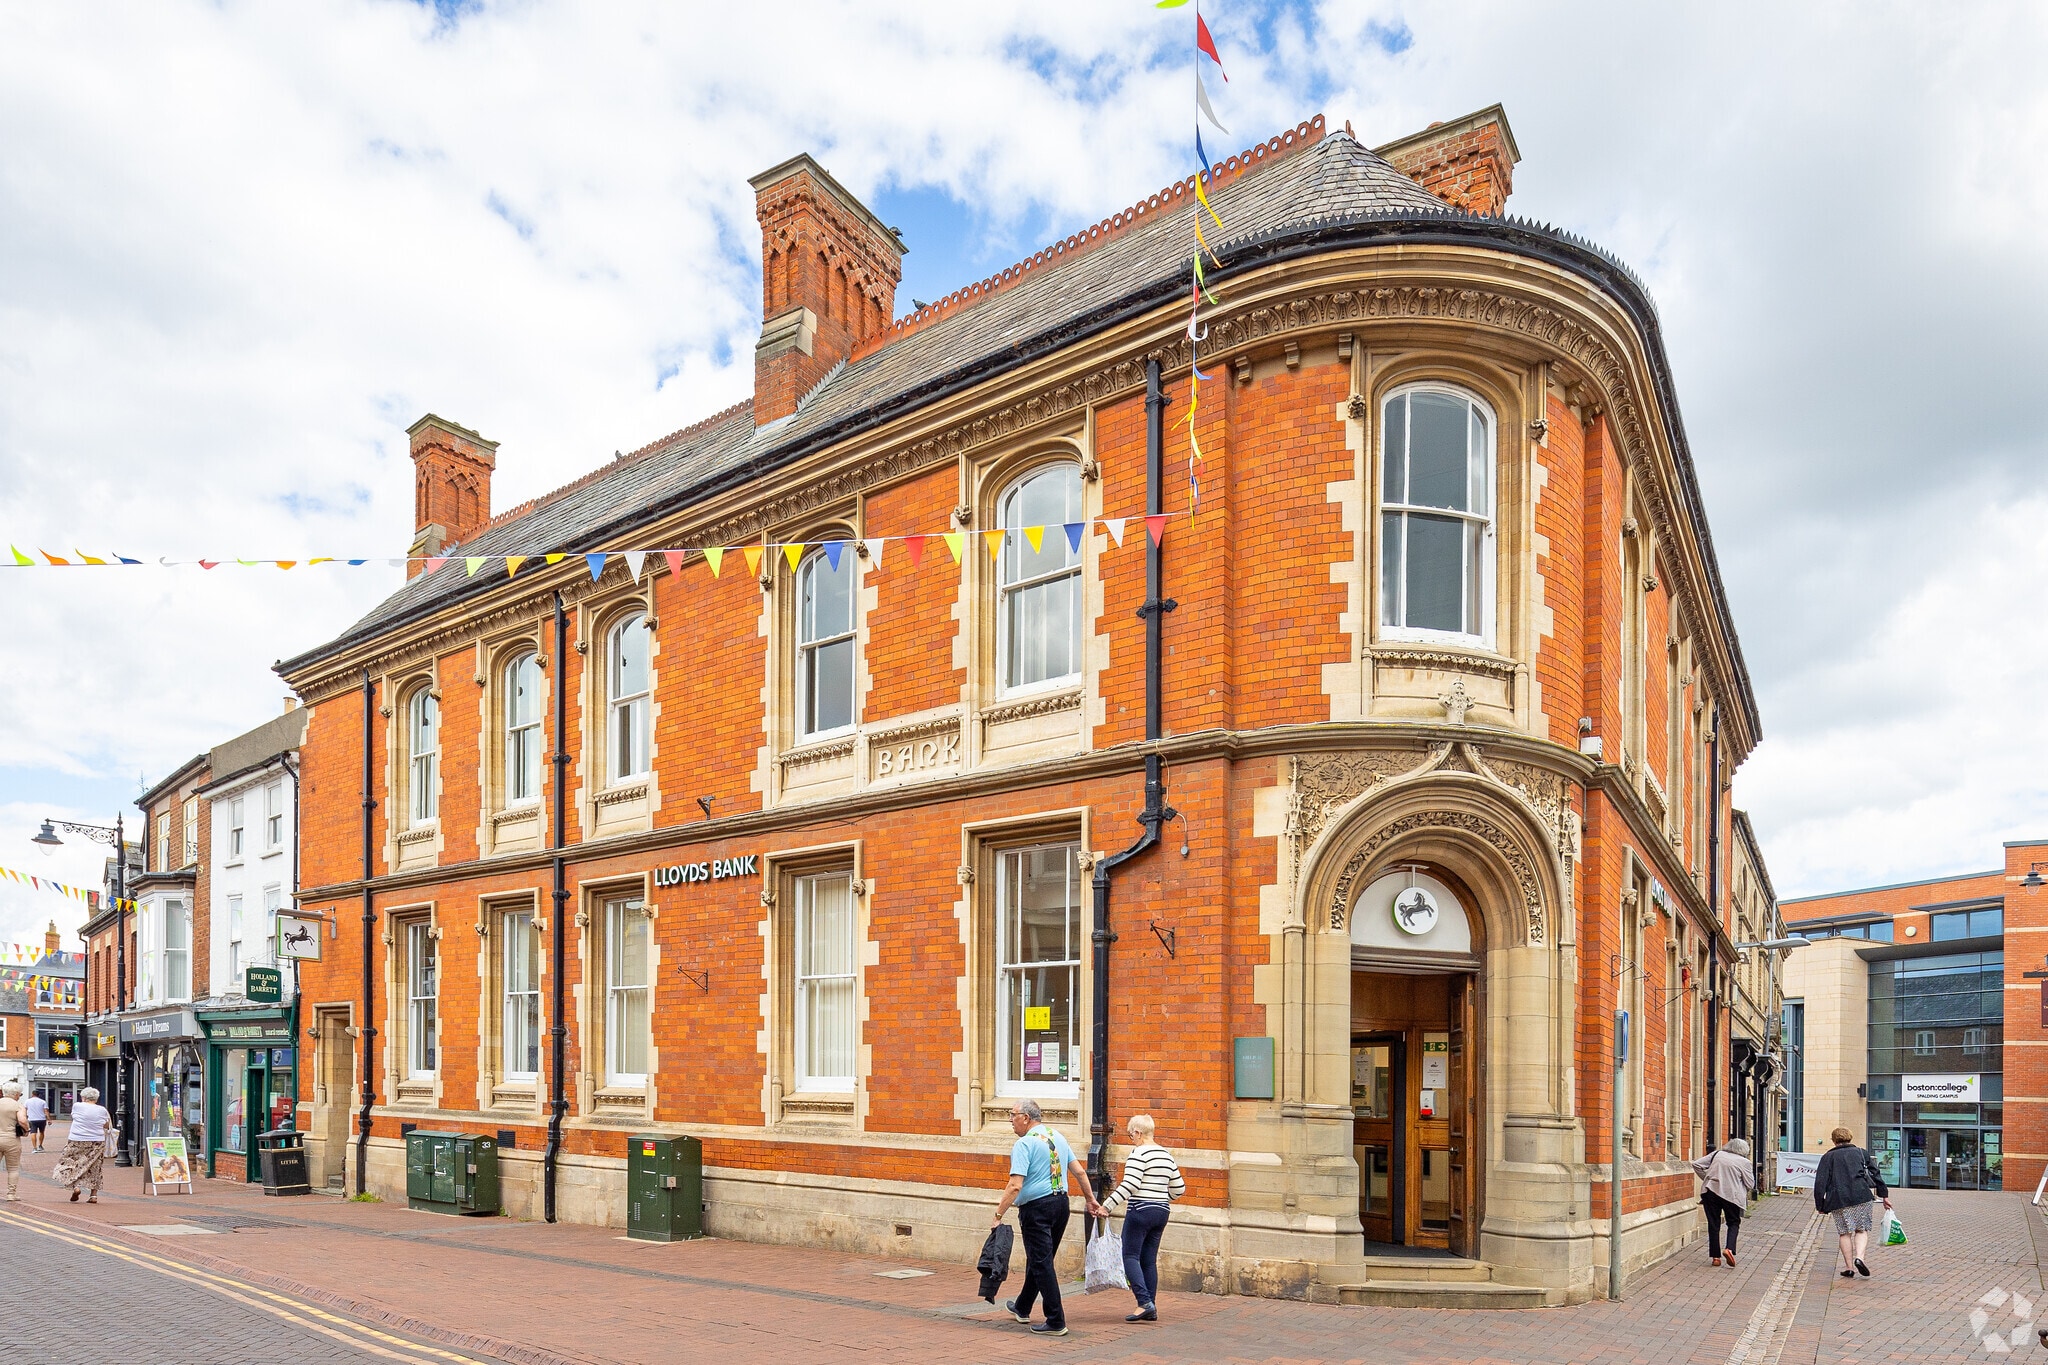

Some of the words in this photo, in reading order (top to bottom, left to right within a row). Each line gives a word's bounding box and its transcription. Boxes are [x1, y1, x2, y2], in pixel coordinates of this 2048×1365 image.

[879, 734, 960, 775] BANK
[654, 861, 709, 887] LLOYDS
[713, 854, 759, 879] BANK
[251, 973, 277, 982] HOLLAND
[251, 986, 277, 994] BARRETT
[135, 1020, 152, 1038] Holiday
[152, 1019, 170, 1033] Dreams
[1907, 1083, 1967, 1093] boston:college
[481, 1141, 491, 1149] 33
